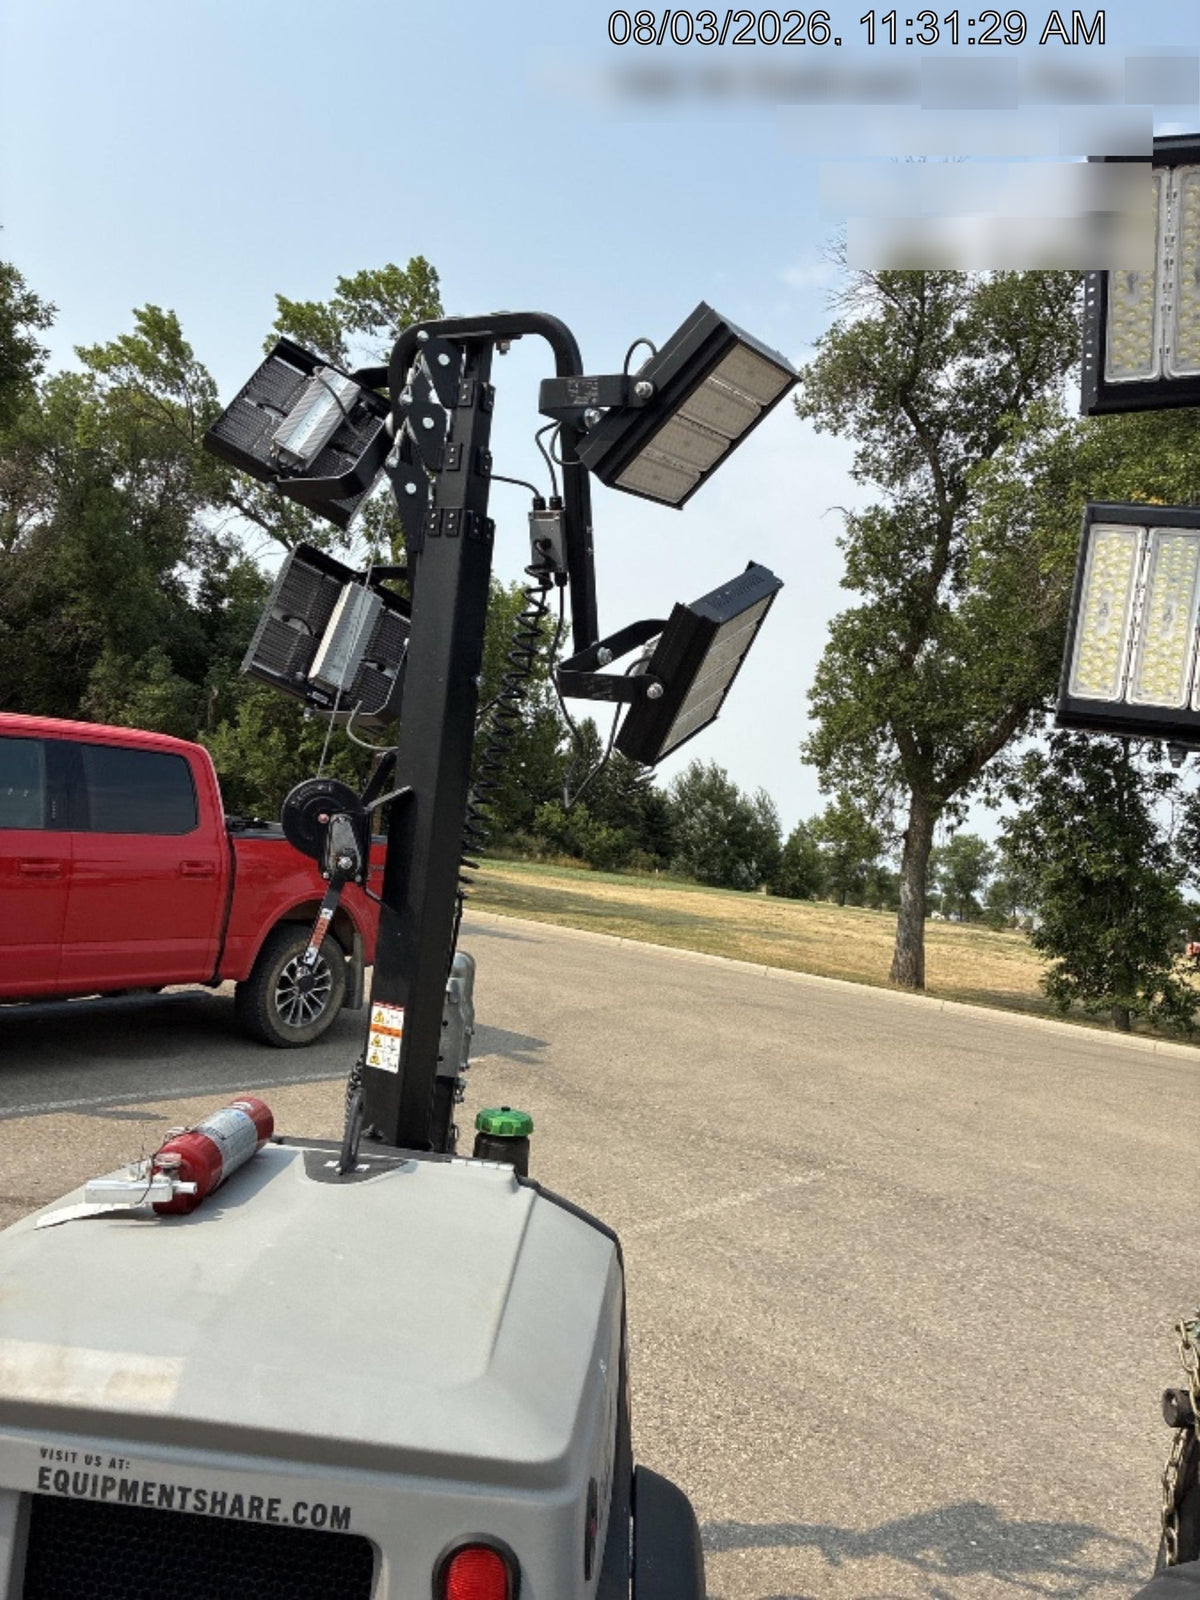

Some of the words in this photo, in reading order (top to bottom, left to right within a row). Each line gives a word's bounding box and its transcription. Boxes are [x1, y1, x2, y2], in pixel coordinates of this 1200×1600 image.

[40, 1447, 78, 1464] VISIT
[84, 1454, 102, 1467] US
[108, 1457, 131, 1470] AT:
[37, 1466, 352, 1530] EQUIPMENTSHARE.COM
